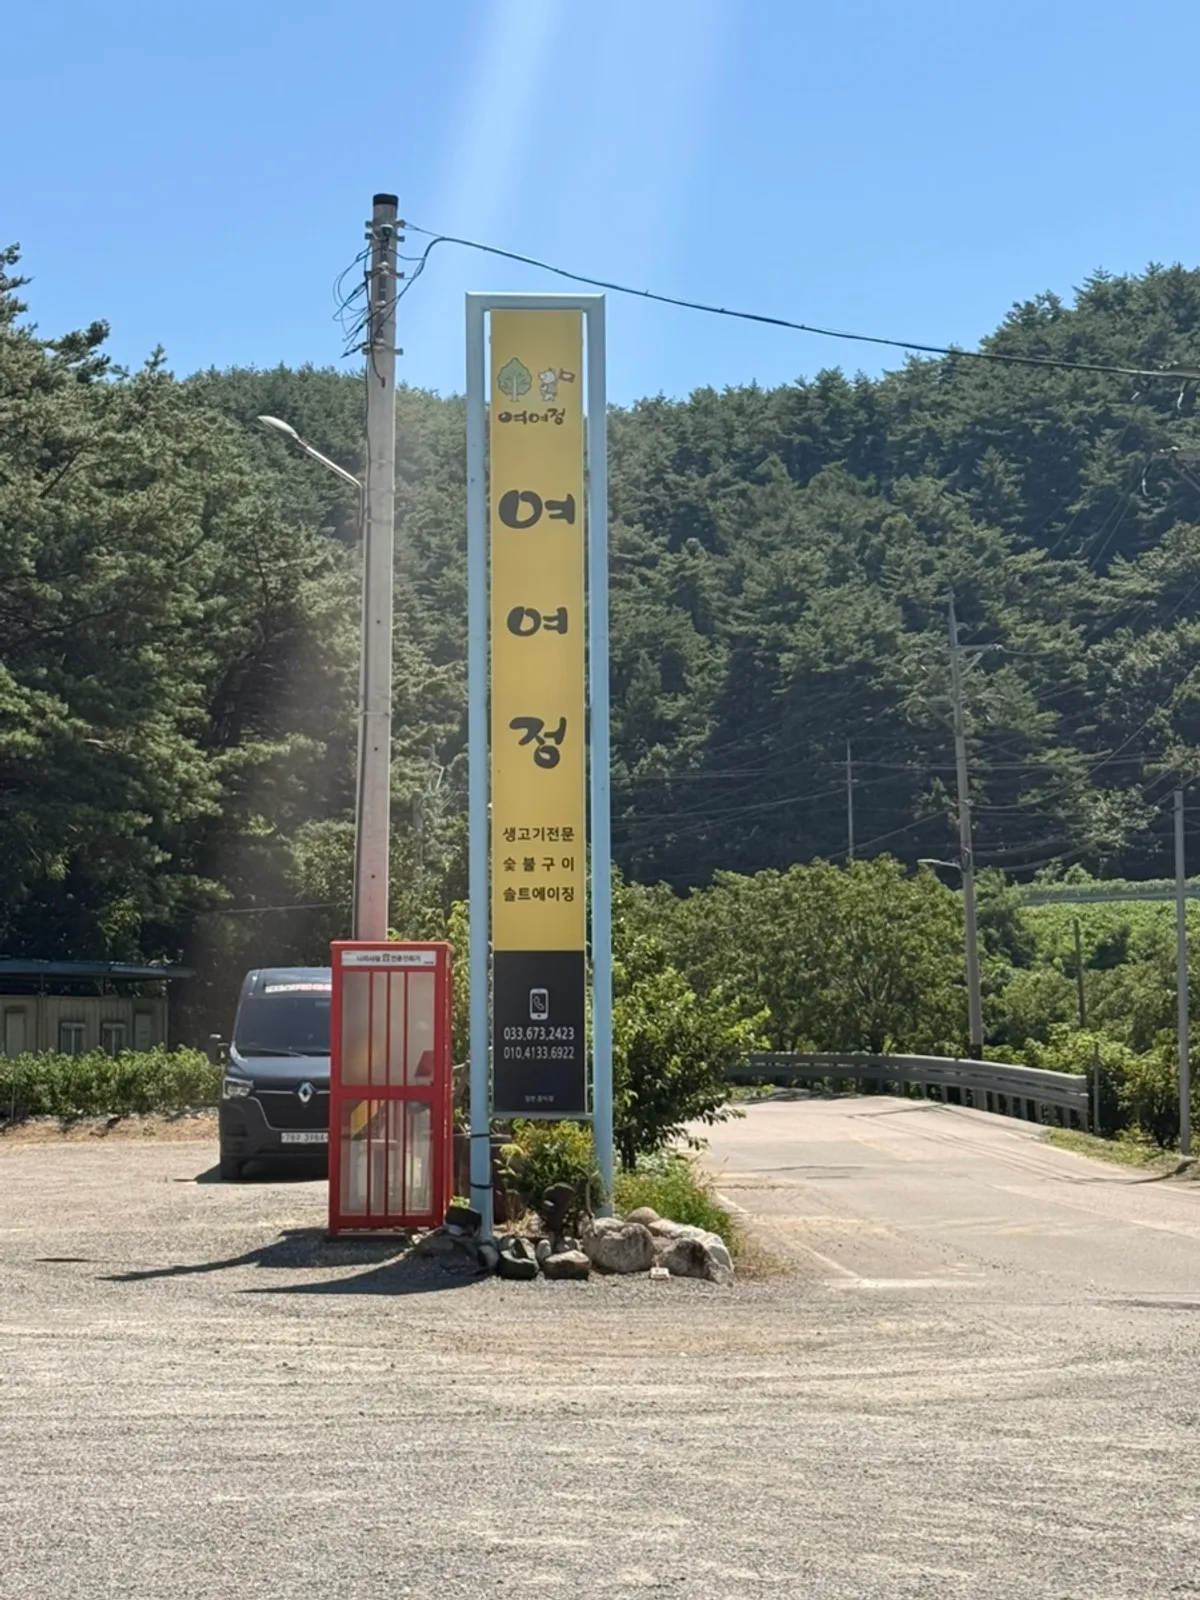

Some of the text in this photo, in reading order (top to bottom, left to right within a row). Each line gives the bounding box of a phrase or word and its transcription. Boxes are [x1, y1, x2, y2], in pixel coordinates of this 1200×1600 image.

[498, 408, 566, 425] 여여정
[503, 826, 574, 842] 생고기전문
[503, 886, 574, 902] 솔트에이징
